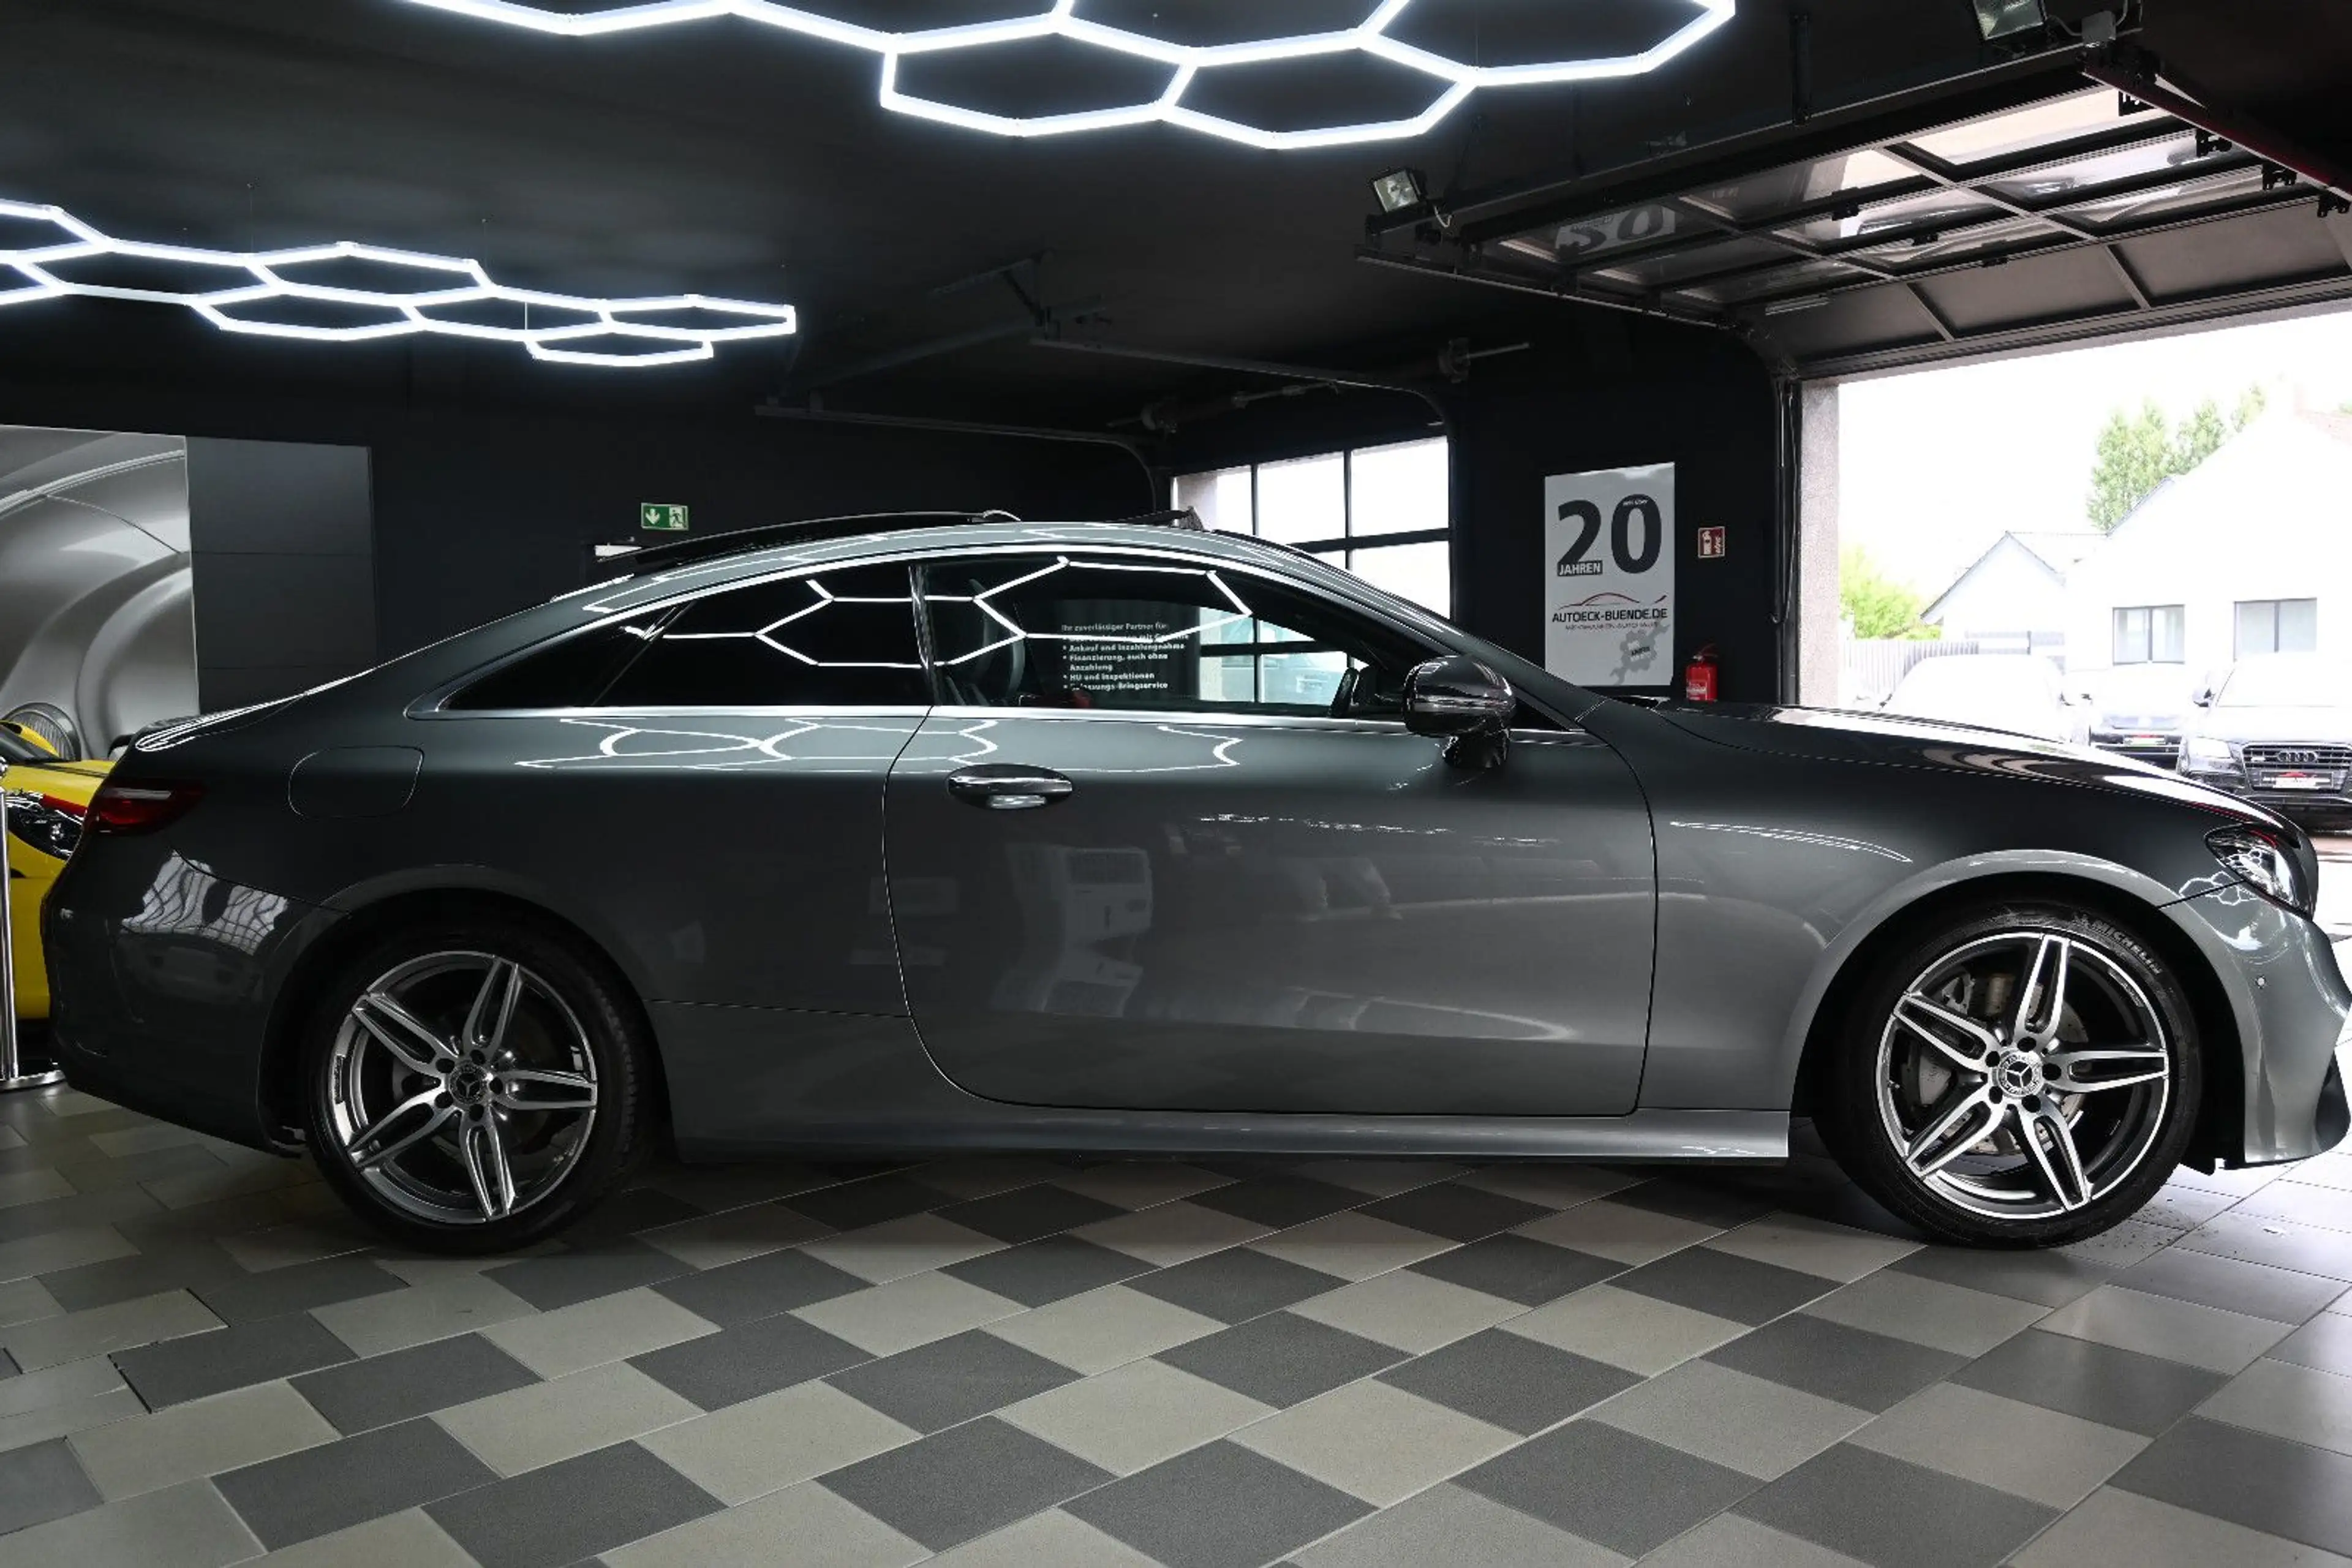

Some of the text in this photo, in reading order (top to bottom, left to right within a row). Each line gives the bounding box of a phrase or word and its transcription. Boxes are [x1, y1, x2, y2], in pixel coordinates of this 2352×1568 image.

[1558, 494, 1662, 574] 20
[1559, 562, 1601, 575] JAHREN
[1552, 608, 1668, 623] AUTOECK-BUENDE.DE
[1069, 644, 1099, 652] Ankauf
[1070, 663, 1113, 672] Anzahlung
[1102, 672, 1155, 681] Inspektionen
